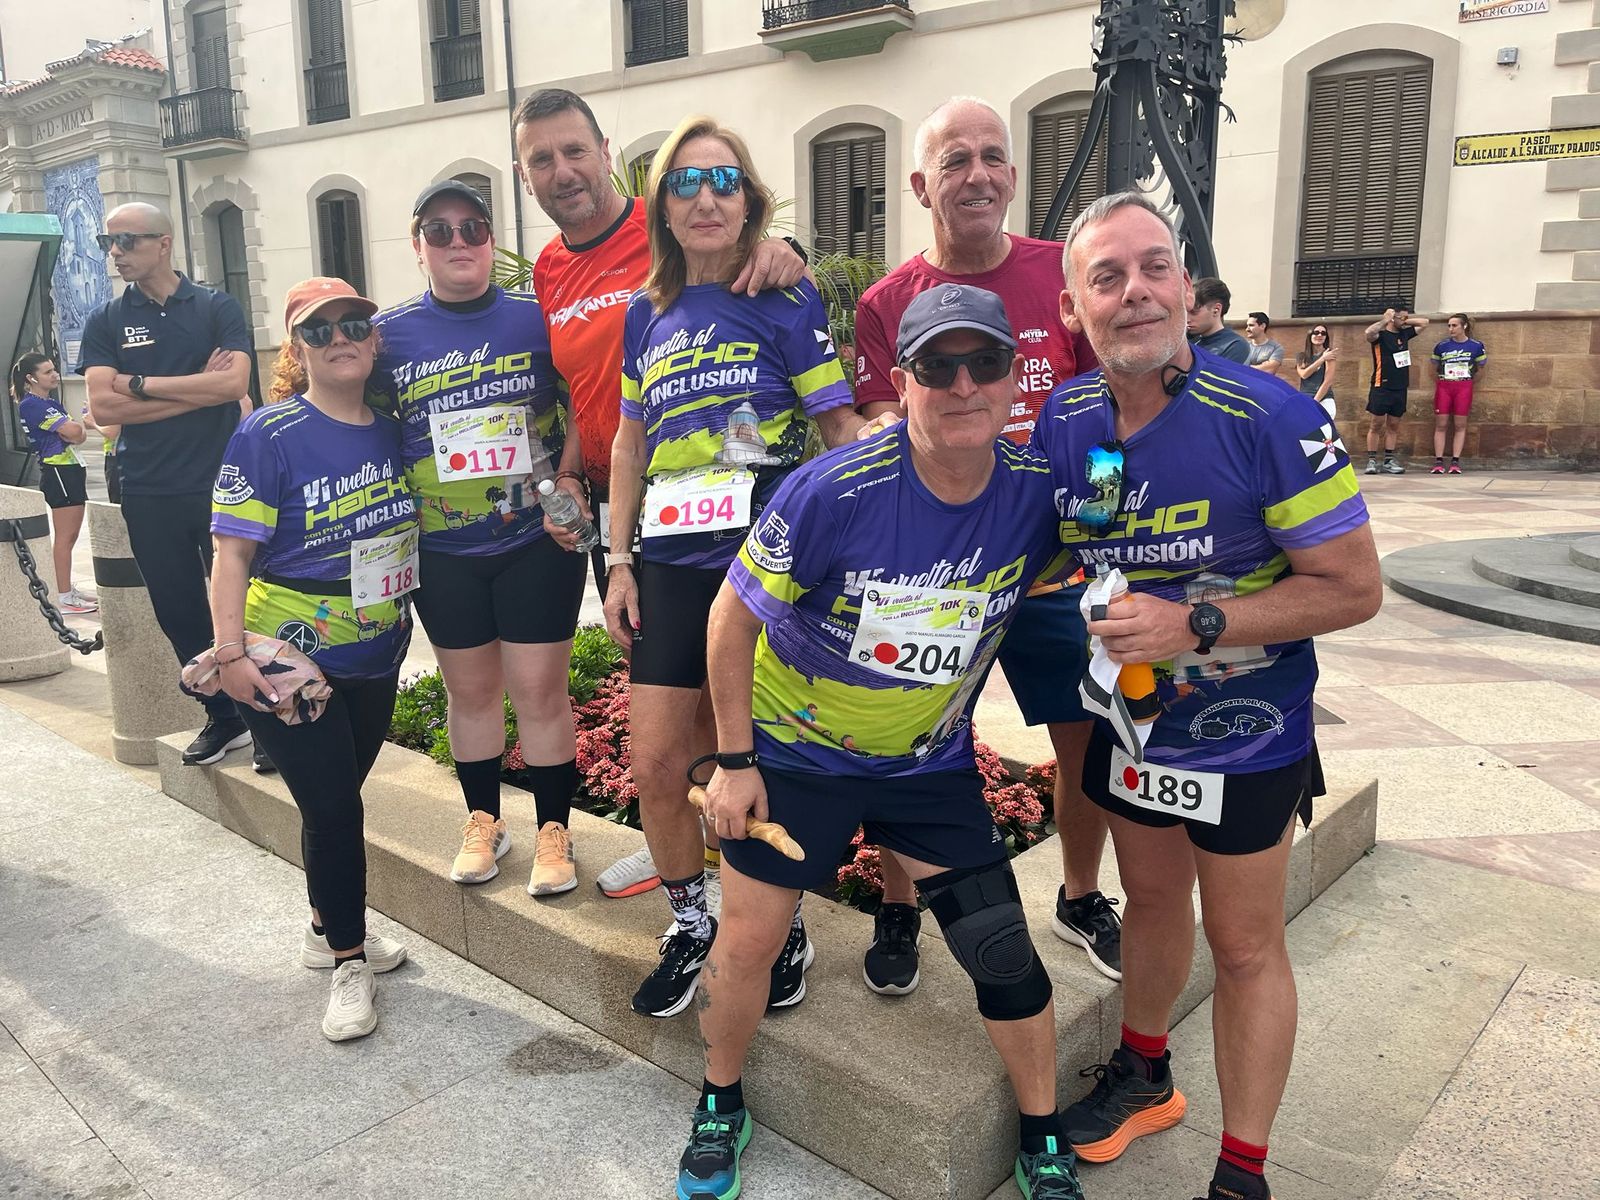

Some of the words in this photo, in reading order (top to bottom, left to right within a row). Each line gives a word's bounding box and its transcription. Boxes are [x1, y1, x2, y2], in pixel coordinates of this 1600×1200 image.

[1461, 1, 1546, 20] MISERICORDIA
[1471, 147, 1508, 160] ALCALDE
[1567, 140, 1600, 153] PRADOS
[1520, 135, 1551, 146] PASEO
[128, 335, 149, 343] BTT
[692, 322, 717, 347] al
[415, 350, 469, 380] vuelta
[469, 342, 491, 364] al
[650, 364, 759, 407] INCLUSIÓN
[415, 410, 428, 422] LA
[428, 374, 537, 414] INCLUSIÓN
[487, 413, 505, 425] 10K
[467, 446, 517, 474] 117
[712, 468, 733, 476] 10K
[302, 475, 331, 509] Vi
[335, 461, 382, 496] vuelta
[382, 458, 394, 482] al
[1123, 480, 1150, 512] al
[678, 495, 735, 527] 194
[304, 534, 333, 549] POR
[333, 528, 353, 543] LA
[1076, 535, 1214, 565] INCLUSIÓN
[760, 557, 793, 569] FUERTES
[953, 547, 983, 581] al
[380, 566, 413, 597] 118
[874, 597, 938, 615] HACHO
[876, 596, 890, 606] Vi
[892, 594, 913, 605] vuelta
[913, 592, 923, 601] al
[940, 598, 962, 611] 10K
[826, 616, 845, 627] con
[900, 606, 934, 618] INCLUSIÓN
[820, 622, 855, 642] POR
[894, 642, 961, 676] 204
[1246, 698, 1258, 706] DEL
[1138, 770, 1203, 811] 189
[671, 897, 697, 909] EUTA
